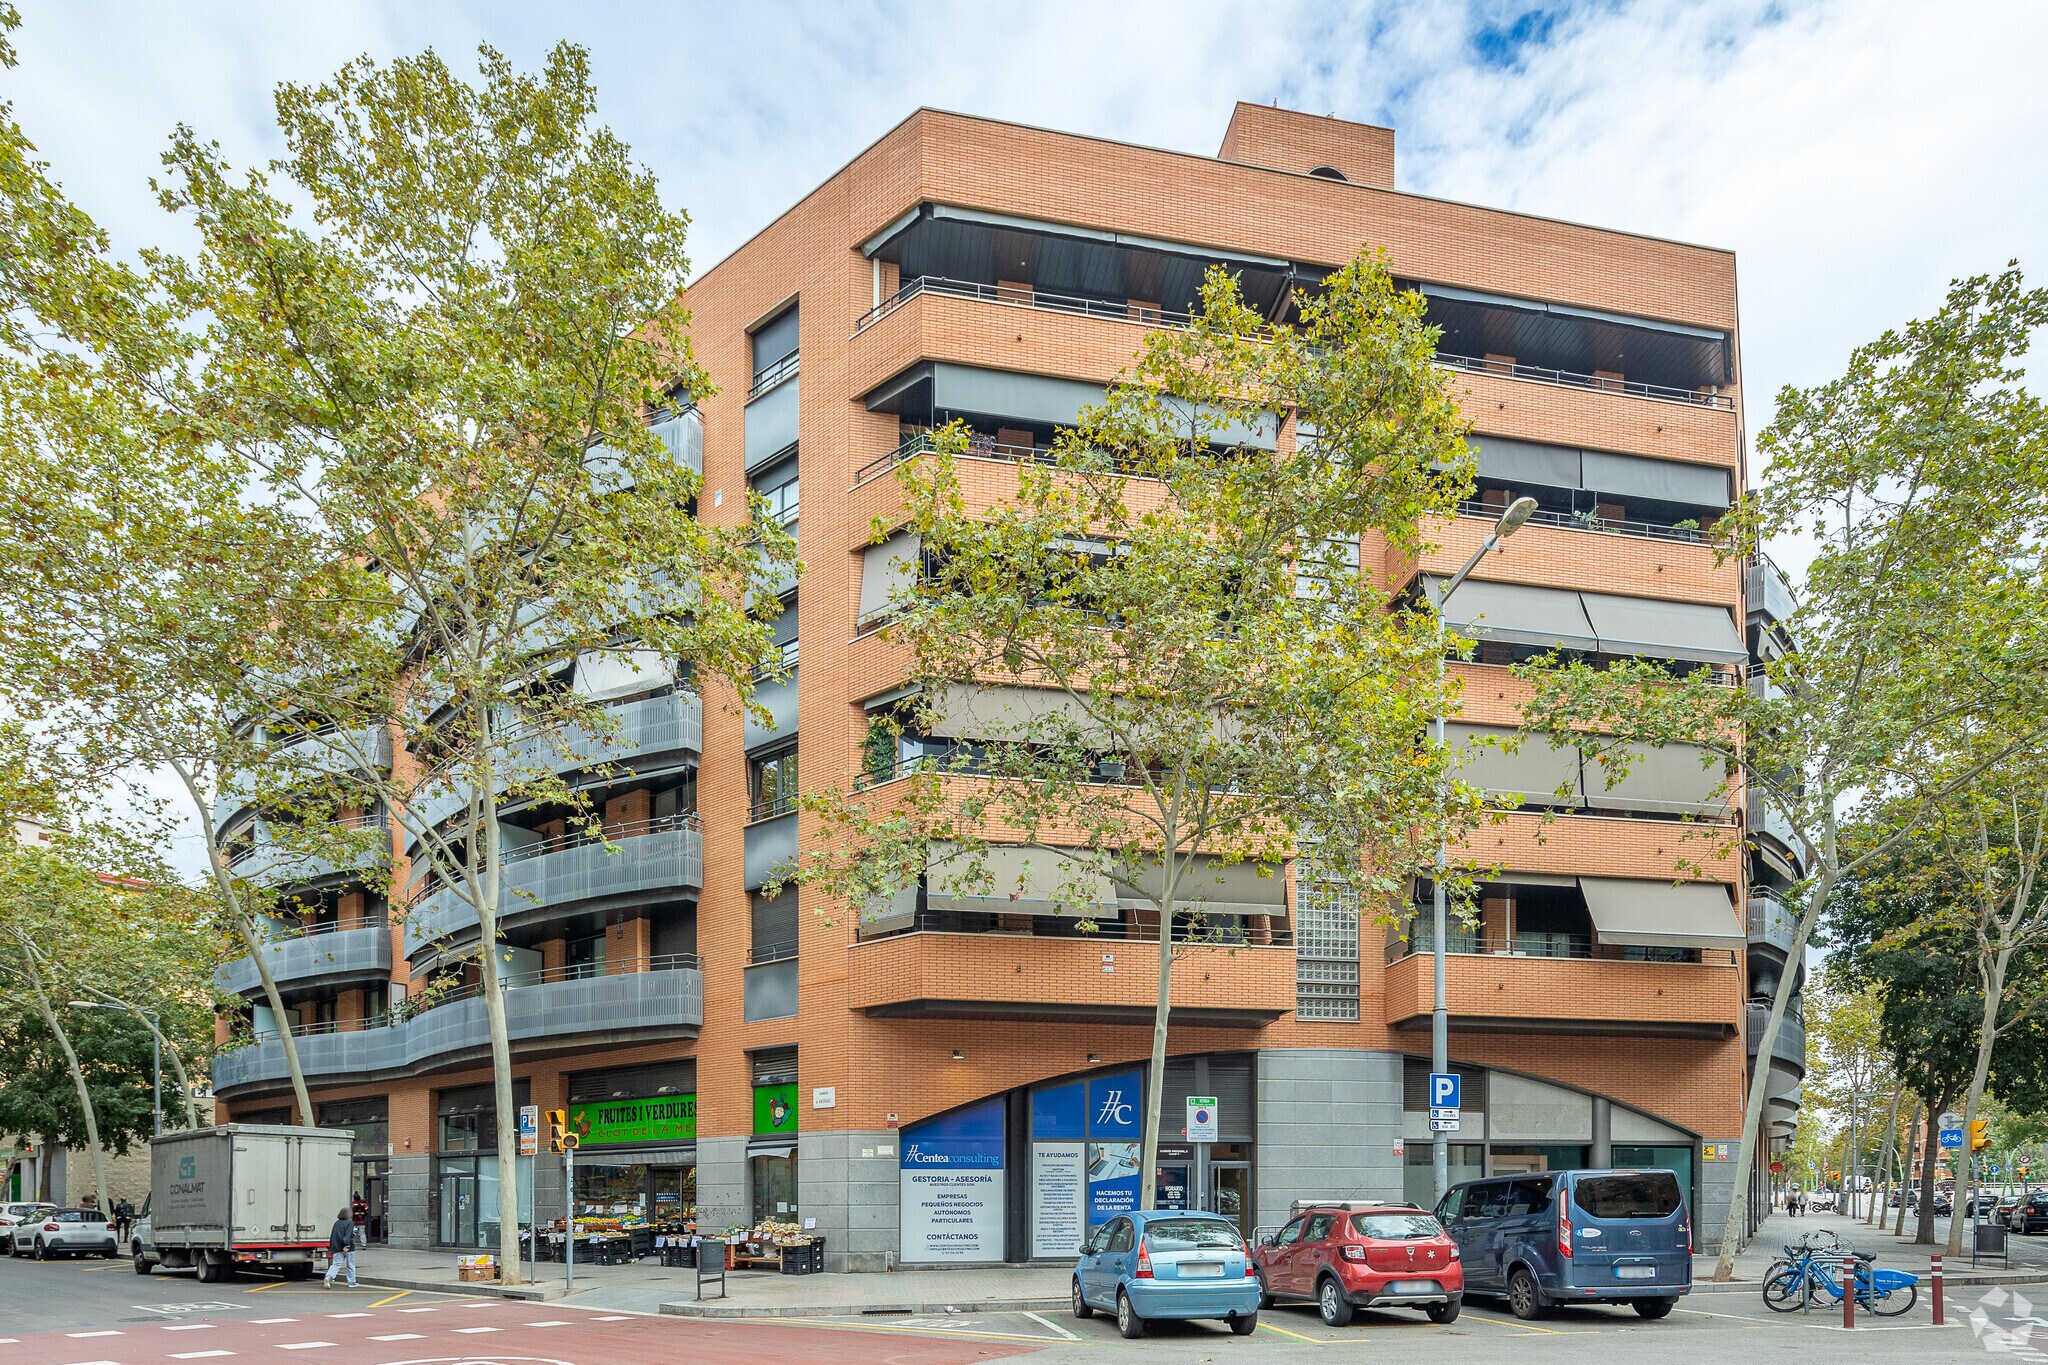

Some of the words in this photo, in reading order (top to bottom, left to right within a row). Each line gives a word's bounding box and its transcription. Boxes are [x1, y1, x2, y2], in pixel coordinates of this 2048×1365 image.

[1436, 1078, 1454, 1104] P
[598, 1106, 636, 1124] FRUITES
[640, 1105, 643, 1121] I
[598, 1128, 627, 1137] CLOT
[632, 1127, 647, 1136] DE
[653, 1125, 668, 1134] LA
